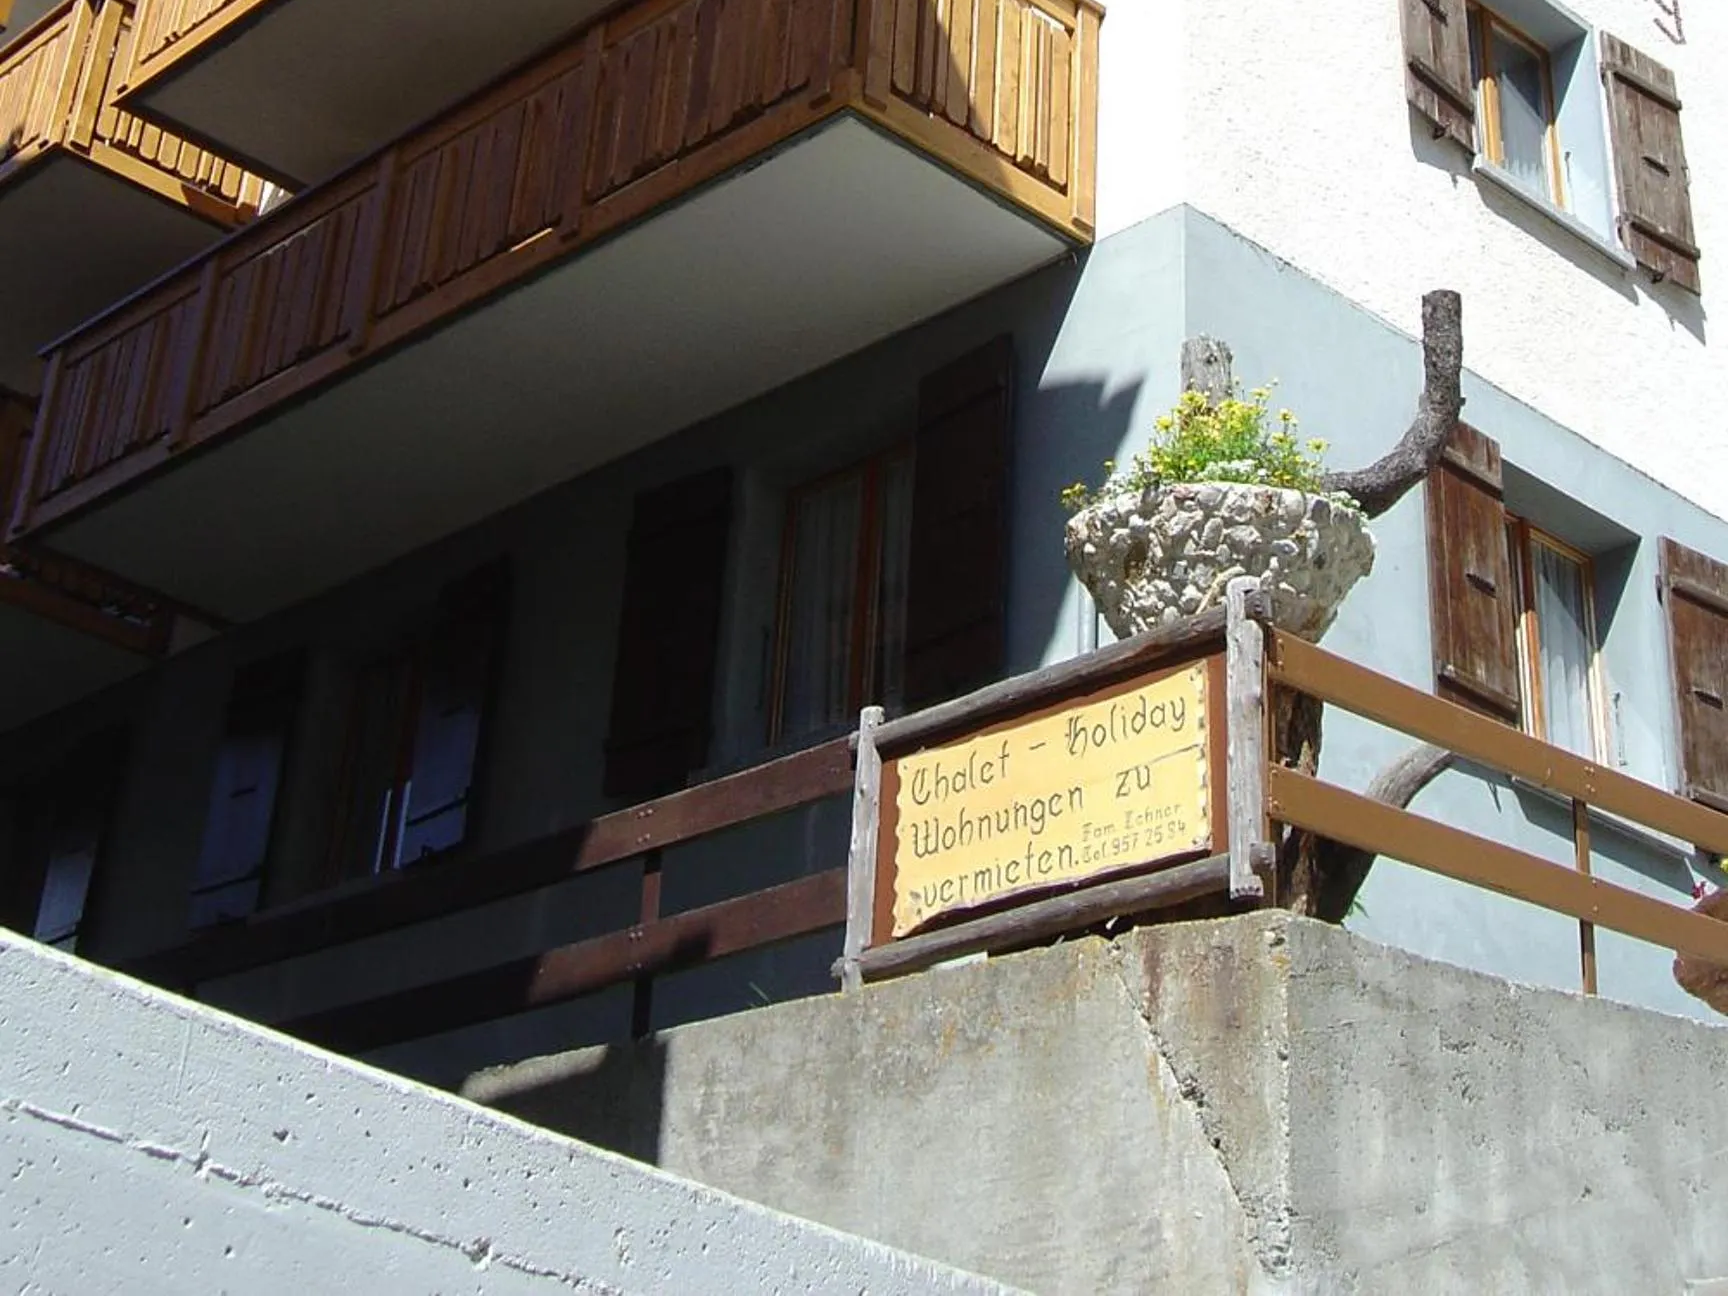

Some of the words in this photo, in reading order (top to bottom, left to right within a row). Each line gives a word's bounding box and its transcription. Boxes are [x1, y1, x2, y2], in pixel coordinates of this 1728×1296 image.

[911, 739, 1010, 806] Chalet
[1065, 695, 1187, 757] Holiday
[911, 785, 1085, 859] Wohnungen
[1115, 764, 1152, 799] zu
[922, 840, 1079, 909] vermieten.
